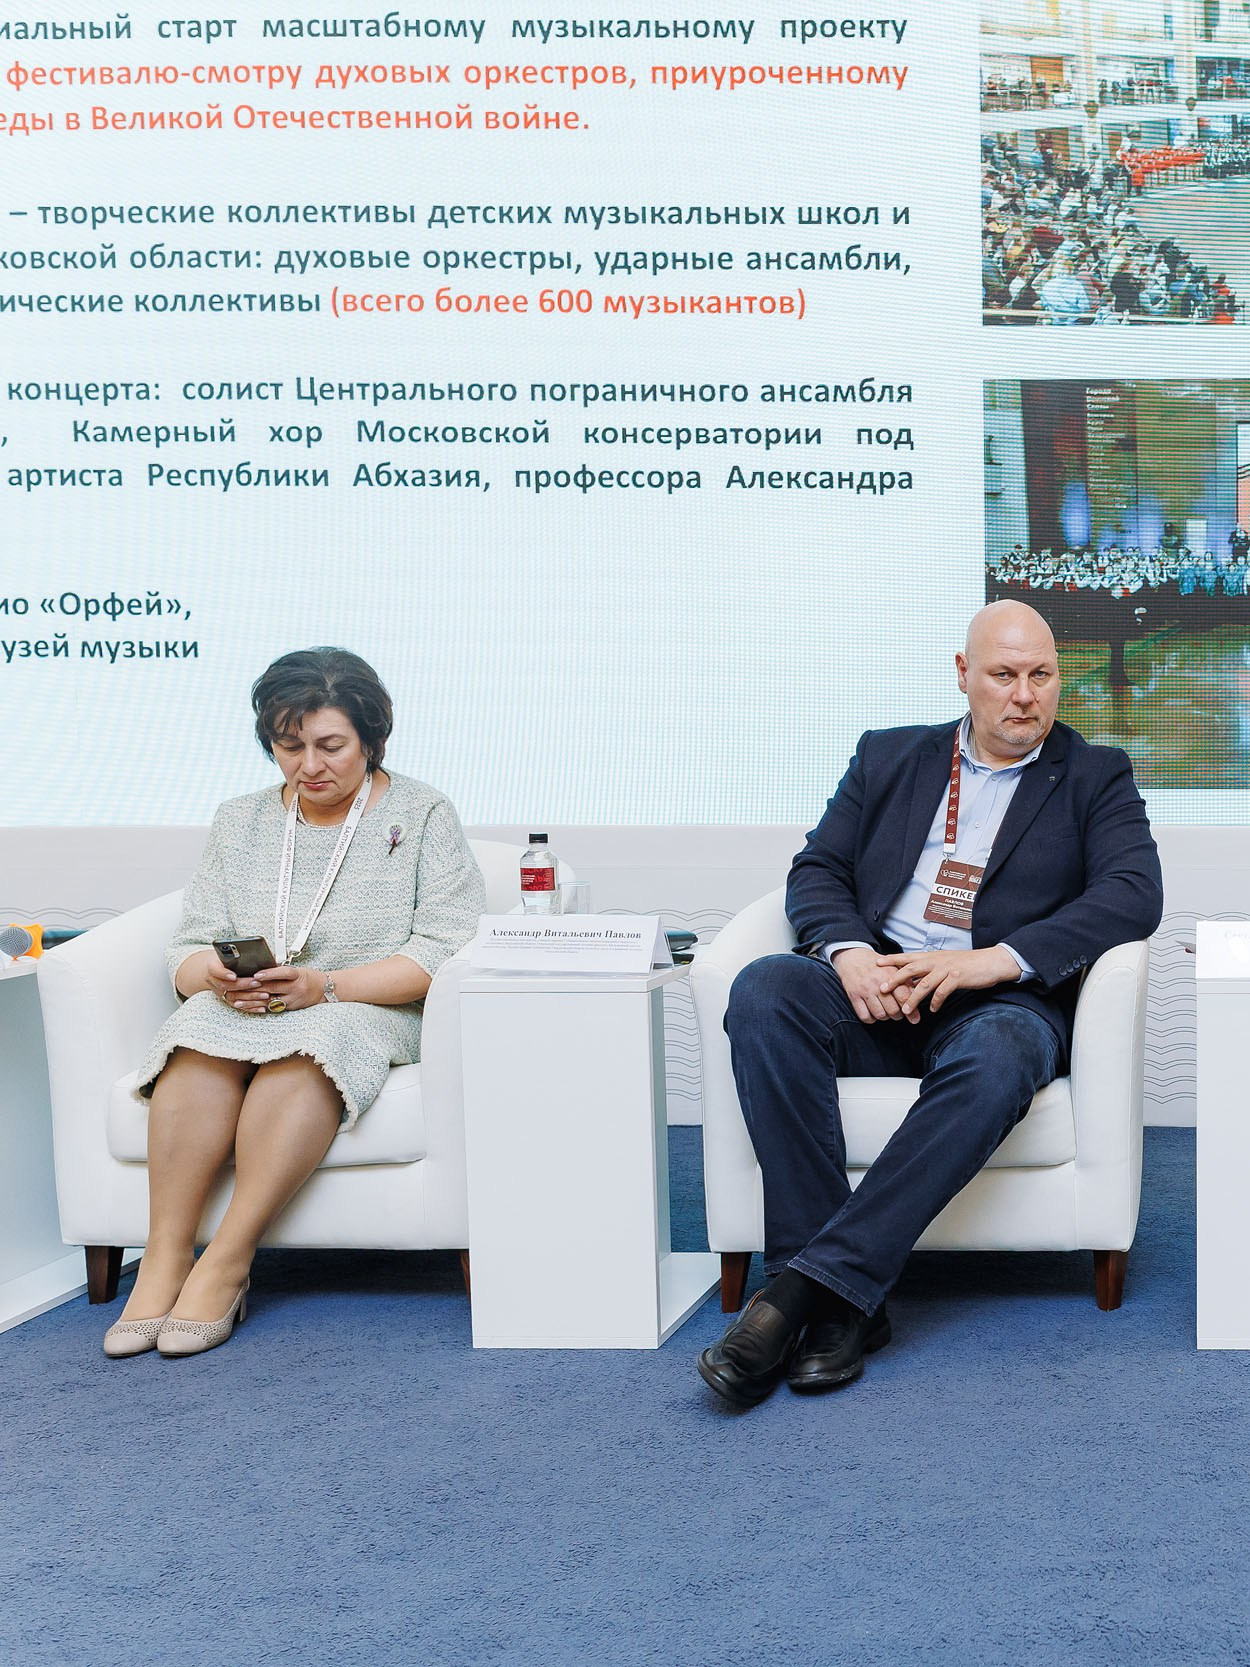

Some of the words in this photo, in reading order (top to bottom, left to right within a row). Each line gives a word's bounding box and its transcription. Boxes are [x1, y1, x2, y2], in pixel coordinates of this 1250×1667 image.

[157, 19, 237, 45] старт
[262, 10, 486, 45] масштабному
[511, 19, 756, 45] музыкальному
[780, 19, 908, 45] проекту
[6, 60, 302, 91] фестивалю-смотру
[315, 65, 450, 89] духовых
[464, 65, 636, 90] оркестров,
[651, 65, 909, 91] приуроченному
[65, 112, 81, 131] в
[92, 103, 223, 130] Великой
[233, 103, 472, 129] Отечественной
[485, 103, 589, 130] войне.
[37, 205, 215, 231] творческие
[227, 204, 415, 224] коллективы
[427, 204, 553, 229] детских
[563, 205, 786, 231] музыкальных
[797, 206, 880, 225] школ
[892, 206, 910, 225] и
[129, 242, 262, 269] области:
[273, 249, 411, 275] духовые
[422, 249, 582, 276] оркестры,
[593, 251, 734, 277] ударные
[746, 243, 911, 276] ансамбли,
[0, 294, 124, 313] ические
[134, 293, 321, 313] коллективы
[331, 286, 425, 318] (всего
[435, 287, 529, 313] более
[539, 288, 593, 314] 600
[603, 287, 806, 320] музыкантов)
[7, 382, 161, 407] концерта:
[182, 381, 284, 401] солист
[295, 376, 518, 407] Центрального
[530, 383, 749, 408] пограничного
[759, 376, 913, 404] ансамбля
[72, 417, 236, 449] Камерный
[268, 425, 323, 449] хор
[357, 419, 550, 445] Московской
[584, 426, 822, 451] консерватории
[856, 427, 915, 451] под
[7, 468, 123, 493] артиста
[147, 460, 329, 493] Республики
[352, 461, 491, 493] Абхазия,
[514, 463, 702, 495] профессора
[725, 465, 913, 496] Александра
[40, 590, 192, 622] «Орфей»,
[0, 632, 70, 664] узей
[80, 640, 199, 665] музыки
[936, 886, 974, 900] СПИКЕ
[489, 928, 542, 939] Александр
[544, 929, 602, 938] Витальевич
[604, 930, 642, 939] Павлов
